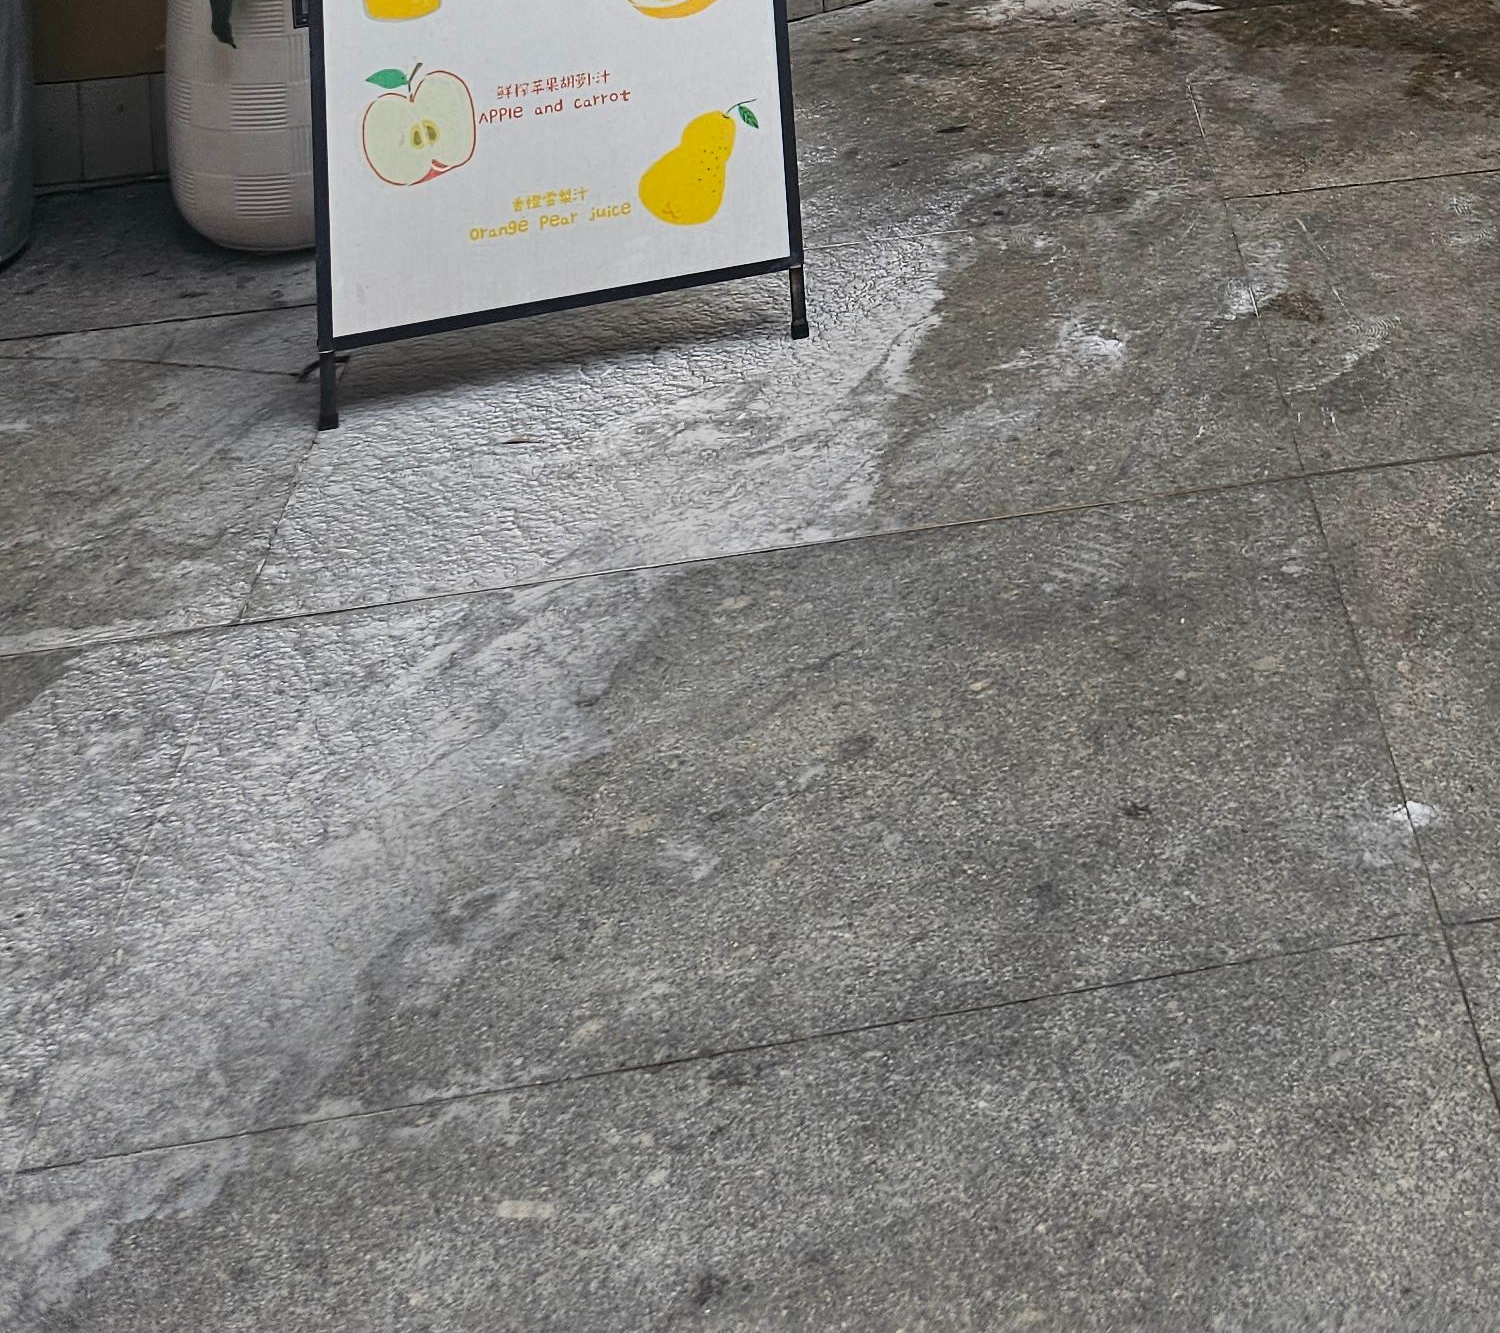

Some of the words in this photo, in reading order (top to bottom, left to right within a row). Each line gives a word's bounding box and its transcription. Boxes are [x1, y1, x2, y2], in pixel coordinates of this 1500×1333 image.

[497, 70, 611, 100] 鲜榨苹果胡萝卜汁
[534, 99, 563, 115] and
[589, 201, 632, 221] juice
